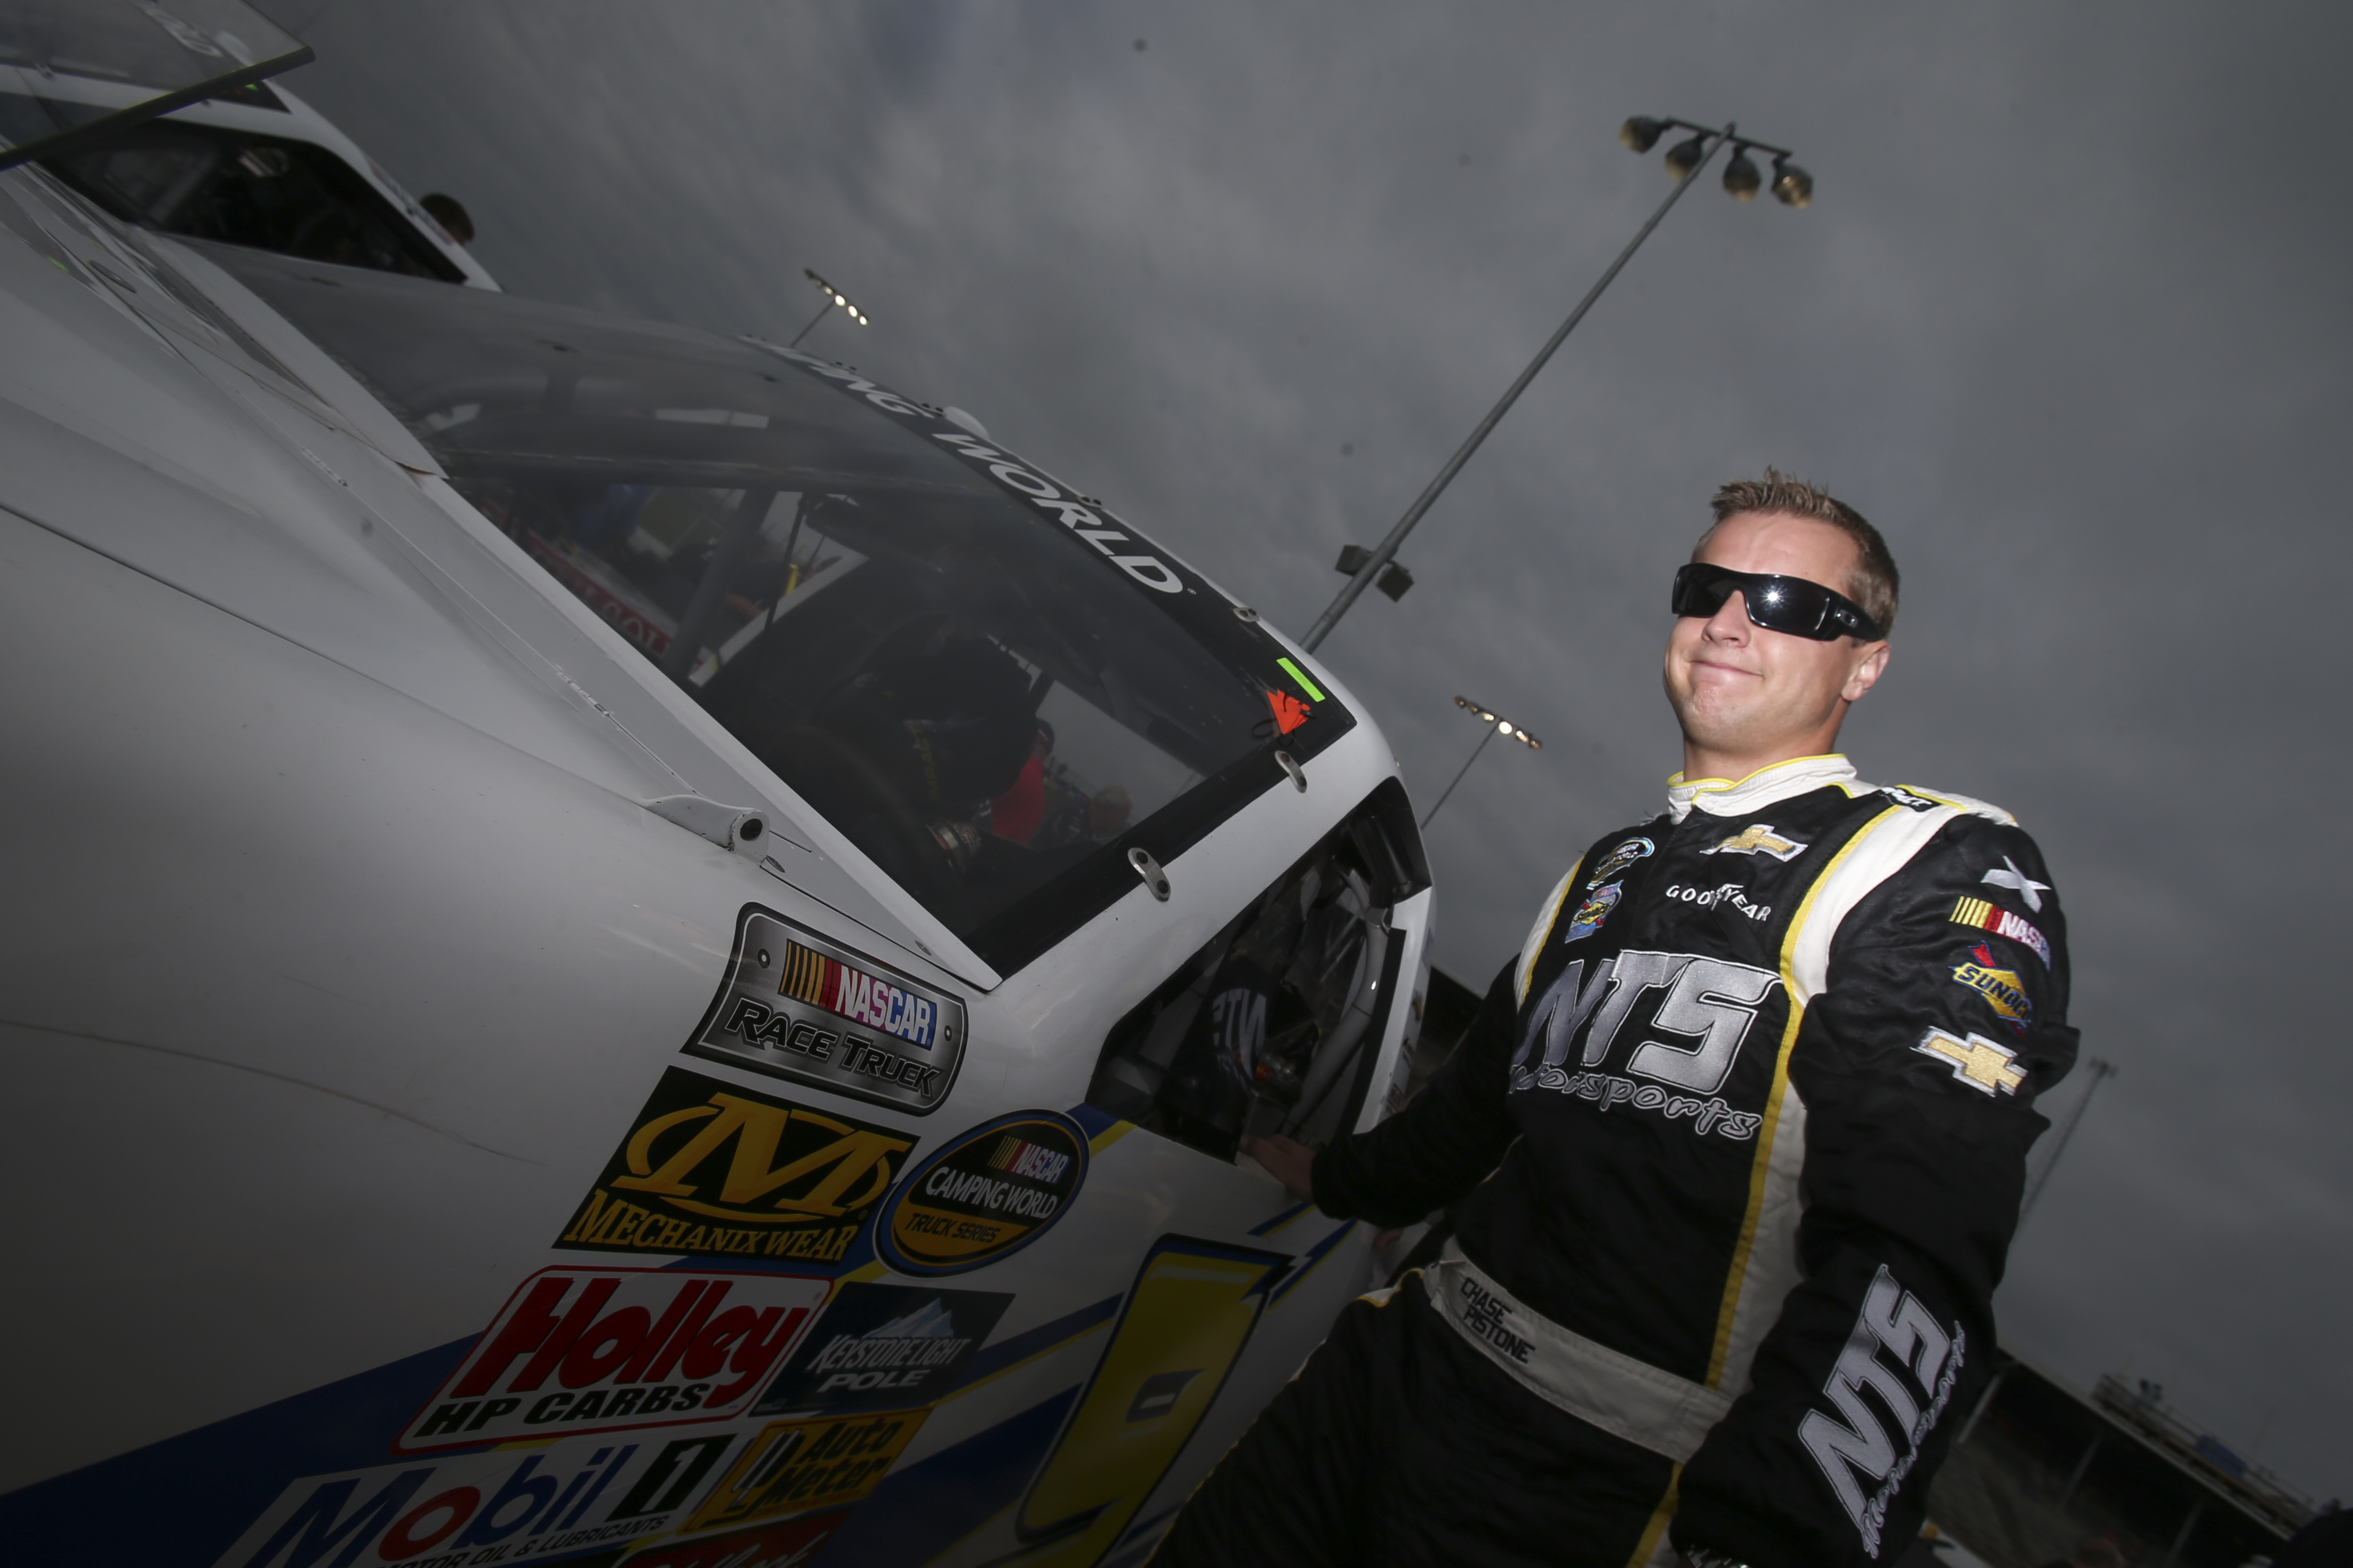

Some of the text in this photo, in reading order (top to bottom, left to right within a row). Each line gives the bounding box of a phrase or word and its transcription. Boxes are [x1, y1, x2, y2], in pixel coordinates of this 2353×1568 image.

[932, 432, 1183, 594] WORLD
[835, 964, 933, 1046] NASCAR
[1512, 949, 1785, 1095] NTS
[725, 998, 944, 1097] RACE TRUCK
[1011, 1142, 1069, 1183] NASCAR
[925, 1166, 1058, 1219] CAMPING WORLD
[563, 1188, 859, 1261] MECHANIX WEAR
[904, 1212, 1002, 1243] TRUCK SERIES
[1460, 1277, 1513, 1325] CHASE
[449, 1277, 811, 1409] Holley
[1463, 1305, 1536, 1364] PISTONE
[816, 1369, 931, 1393] POLE
[1797, 1263, 1951, 1532] NTS
[412, 1383, 711, 1438] HP CARBS
[793, 1417, 905, 1465] Auto
[241, 1444, 641, 1568] Mobil
[763, 1454, 892, 1506] Meter
[468, 1542, 512, 1566] OIL
[515, 1539, 537, 1557] &
[536, 1515, 670, 1553] LUBRICANTS
